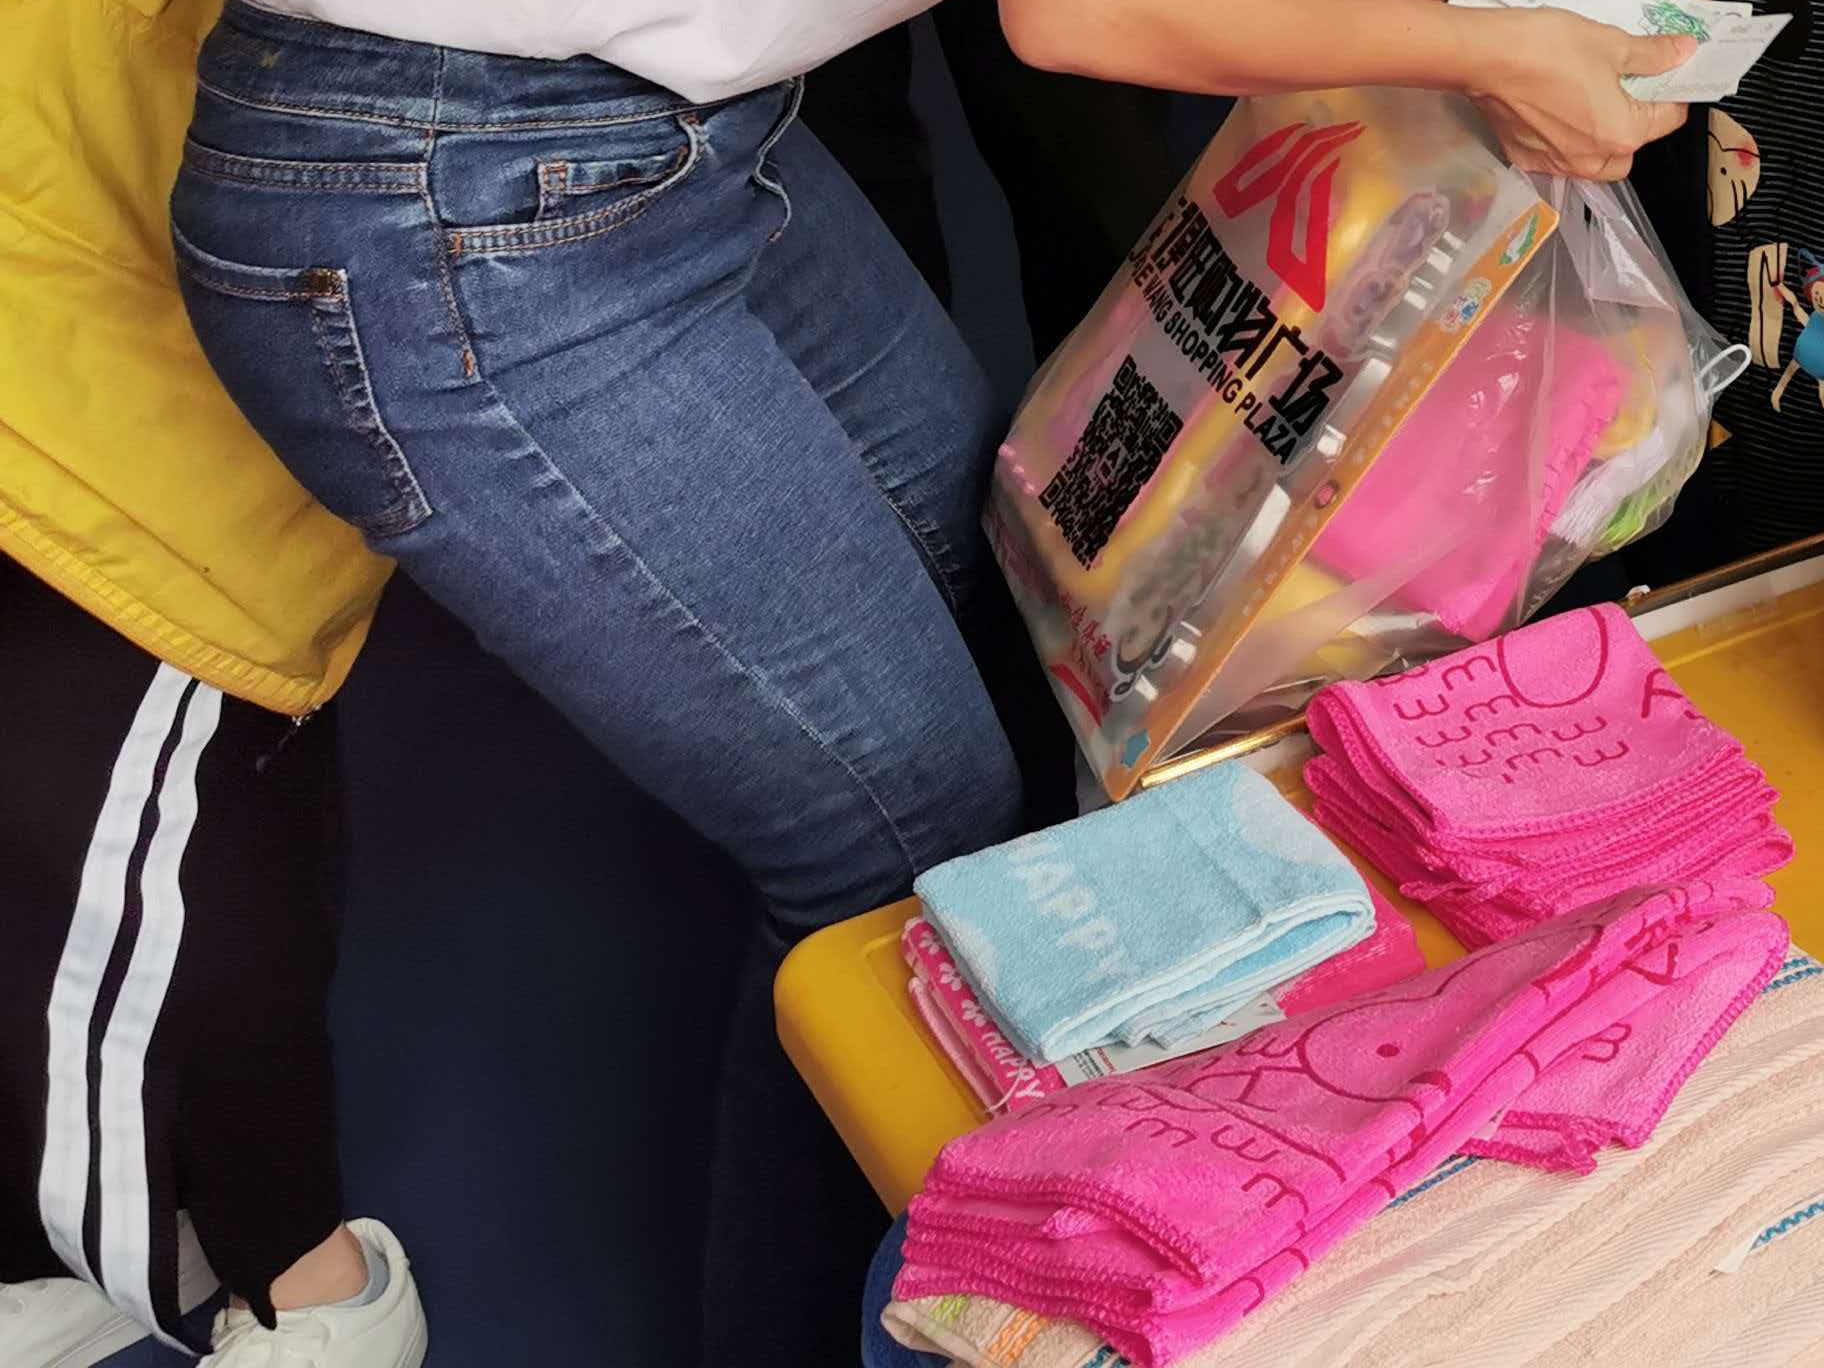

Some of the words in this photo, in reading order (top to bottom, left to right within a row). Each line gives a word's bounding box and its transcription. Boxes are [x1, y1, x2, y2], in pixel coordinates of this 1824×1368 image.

[1141, 272, 1172, 329] WANG
[1162, 310, 1244, 405] SHOPPING
[1234, 391, 1300, 466] PLAZA
[1150, 196, 1344, 436] 得旺购物广场
